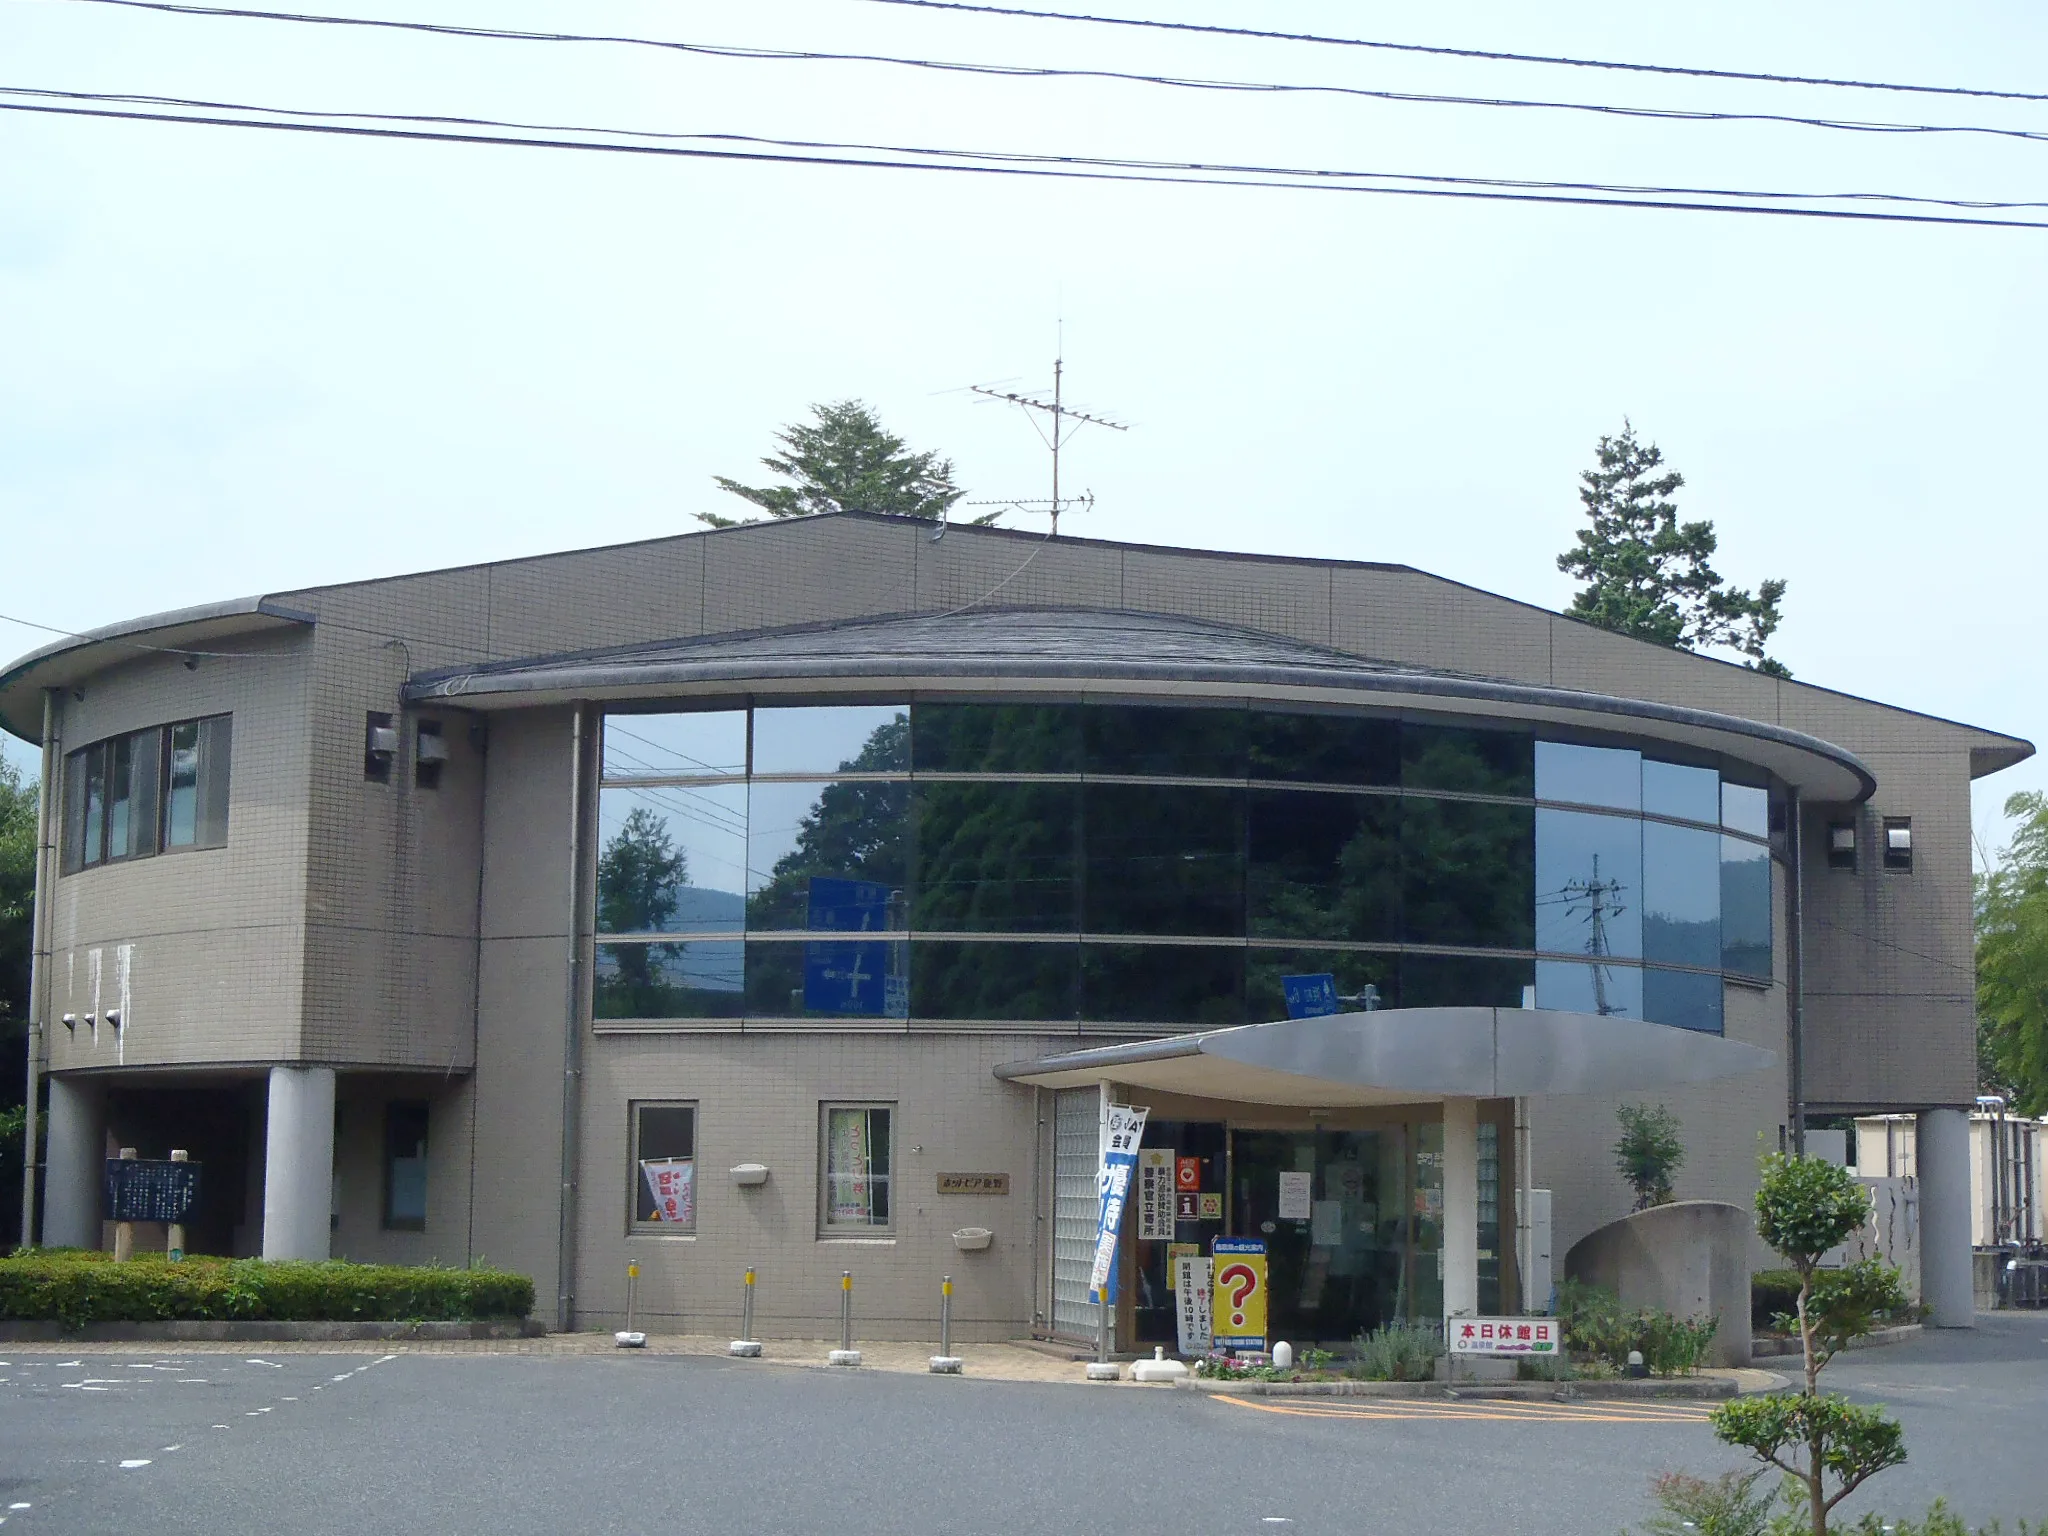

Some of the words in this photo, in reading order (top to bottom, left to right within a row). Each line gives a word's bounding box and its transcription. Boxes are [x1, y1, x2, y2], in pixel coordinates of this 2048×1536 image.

[1112, 1134, 1132, 1150] 会員
[1144, 1167, 1155, 1236] 警察官立寄所
[1460, 1323, 1548, 1341] 本日休館日
